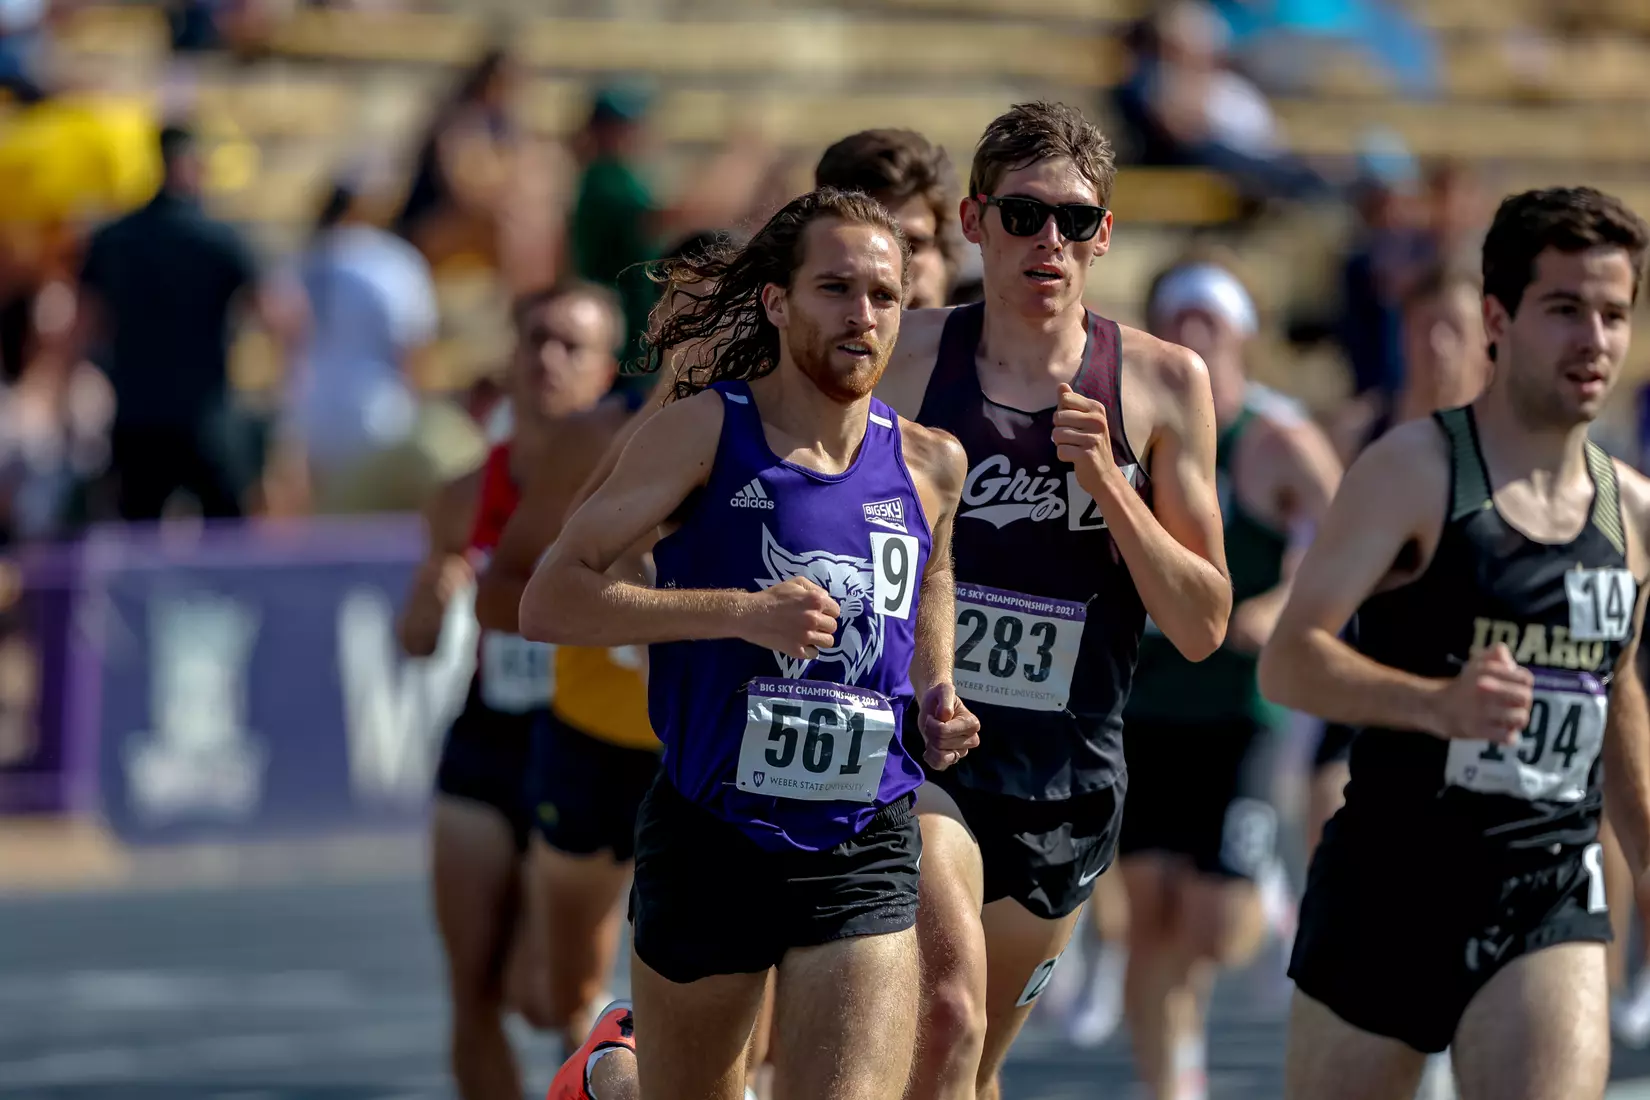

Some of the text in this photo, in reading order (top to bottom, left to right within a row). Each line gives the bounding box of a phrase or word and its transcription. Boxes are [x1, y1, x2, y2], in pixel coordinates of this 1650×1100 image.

[730, 496, 775, 510] adidas
[961, 454, 1066, 522] Griz
[881, 537, 910, 613] 9
[968, 589, 984, 600] SKY
[985, 593, 1054, 613] CHAMPIONSHIPS
[1055, 605, 1075, 616] 2021
[1582, 574, 1626, 635] 14
[955, 608, 1058, 683] 283
[759, 683, 879, 707] BIG SKY CHAMPIONSHIPS 2021
[956, 679, 1056, 700] WEBER STATE UNIVERSITY
[764, 703, 866, 775] 561
[770, 776, 864, 792] WEBER STATE UNIVERSITY
